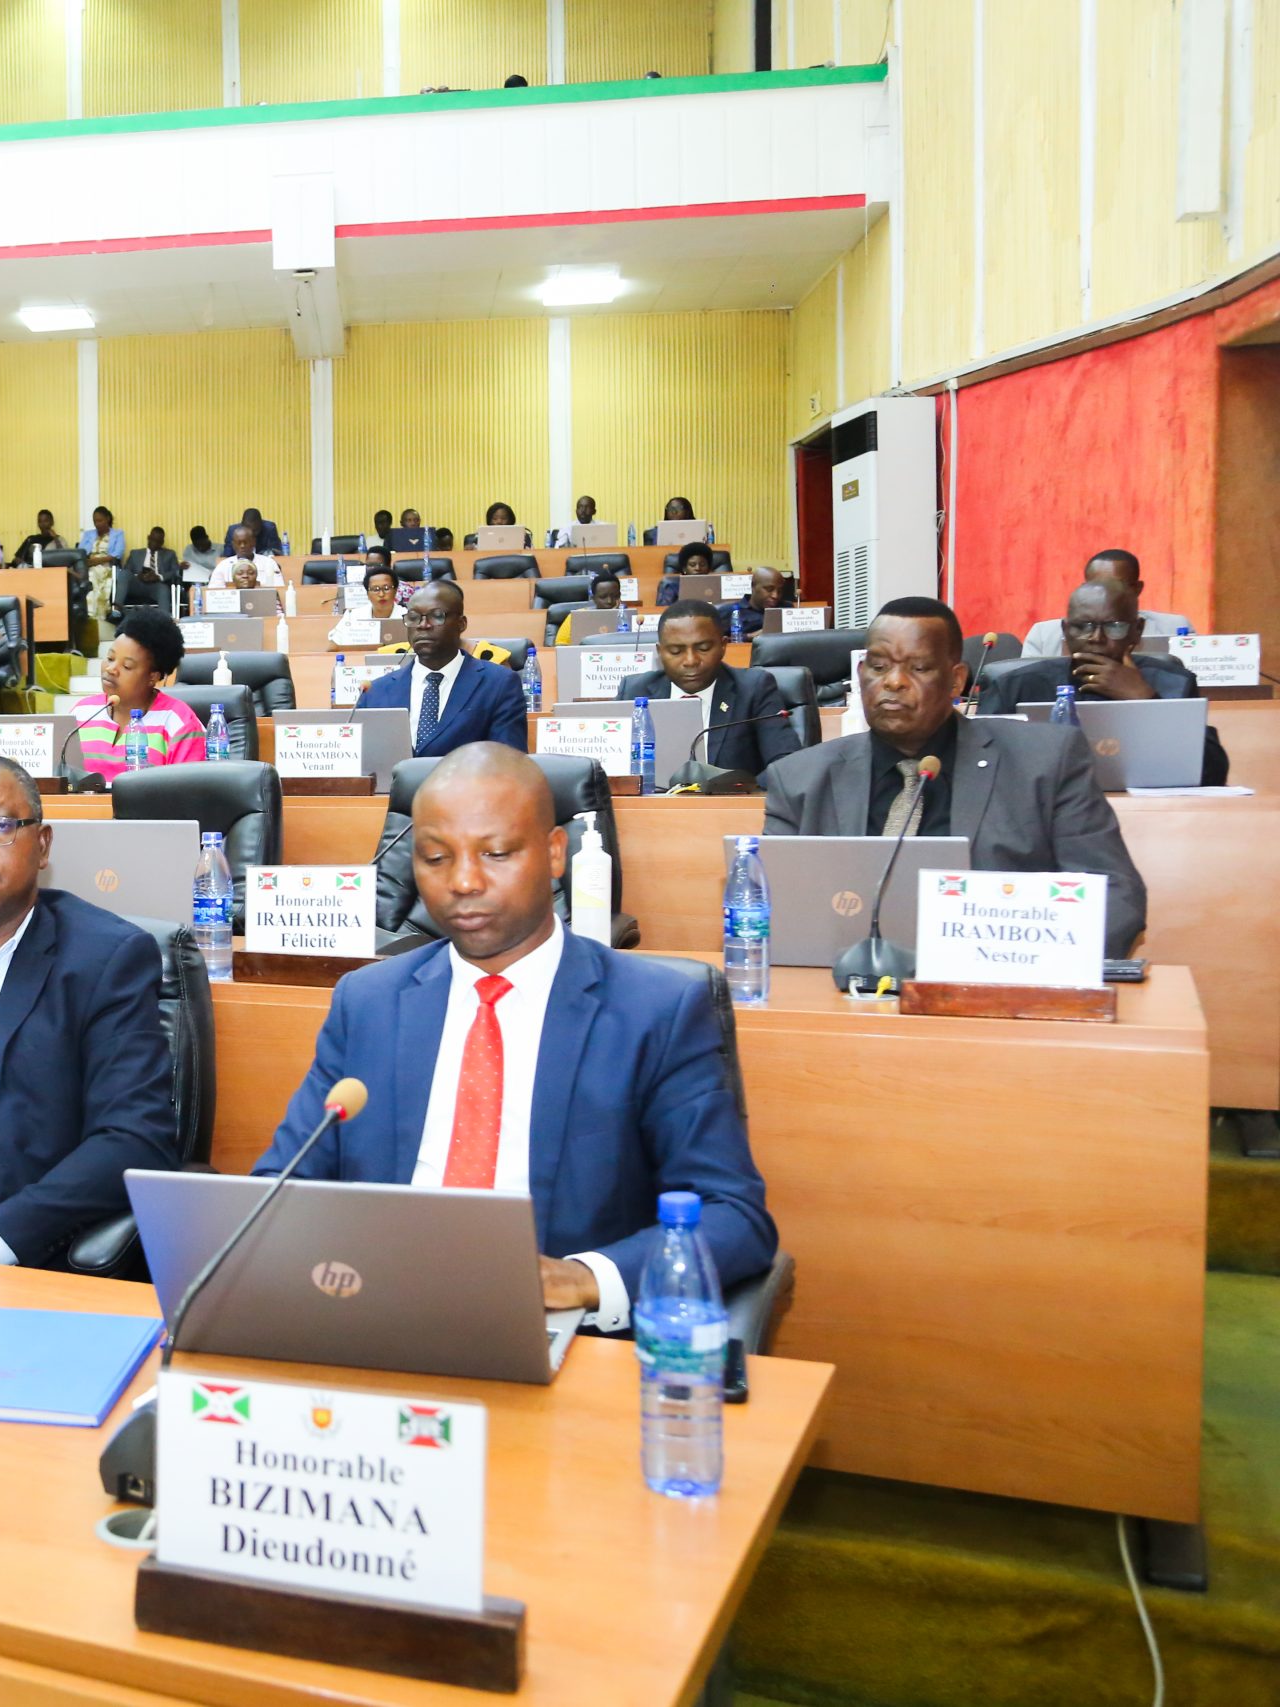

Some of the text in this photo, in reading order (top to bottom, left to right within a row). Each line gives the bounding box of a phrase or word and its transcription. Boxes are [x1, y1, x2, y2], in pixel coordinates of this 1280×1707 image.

[1198, 673, 1235, 682] acifique
[296, 740, 341, 748] Honorable
[279, 751, 359, 759] MANIRAMBONA
[302, 762, 334, 771] Venant
[96, 868, 117, 891] hp
[275, 894, 343, 907] Honorable
[834, 892, 861, 916] hp
[256, 912, 362, 928] IRAHARIRA
[962, 902, 1059, 921] Honorable
[280, 932, 337, 948] Félicité
[940, 921, 1077, 946] IRAMBONA
[975, 947, 1040, 965] Nestor
[316, 1262, 359, 1297] hp
[235, 1438, 405, 1486] Honorable
[209, 1477, 430, 1536] BIZIMANA
[220, 1523, 417, 1582] Dieudonné
